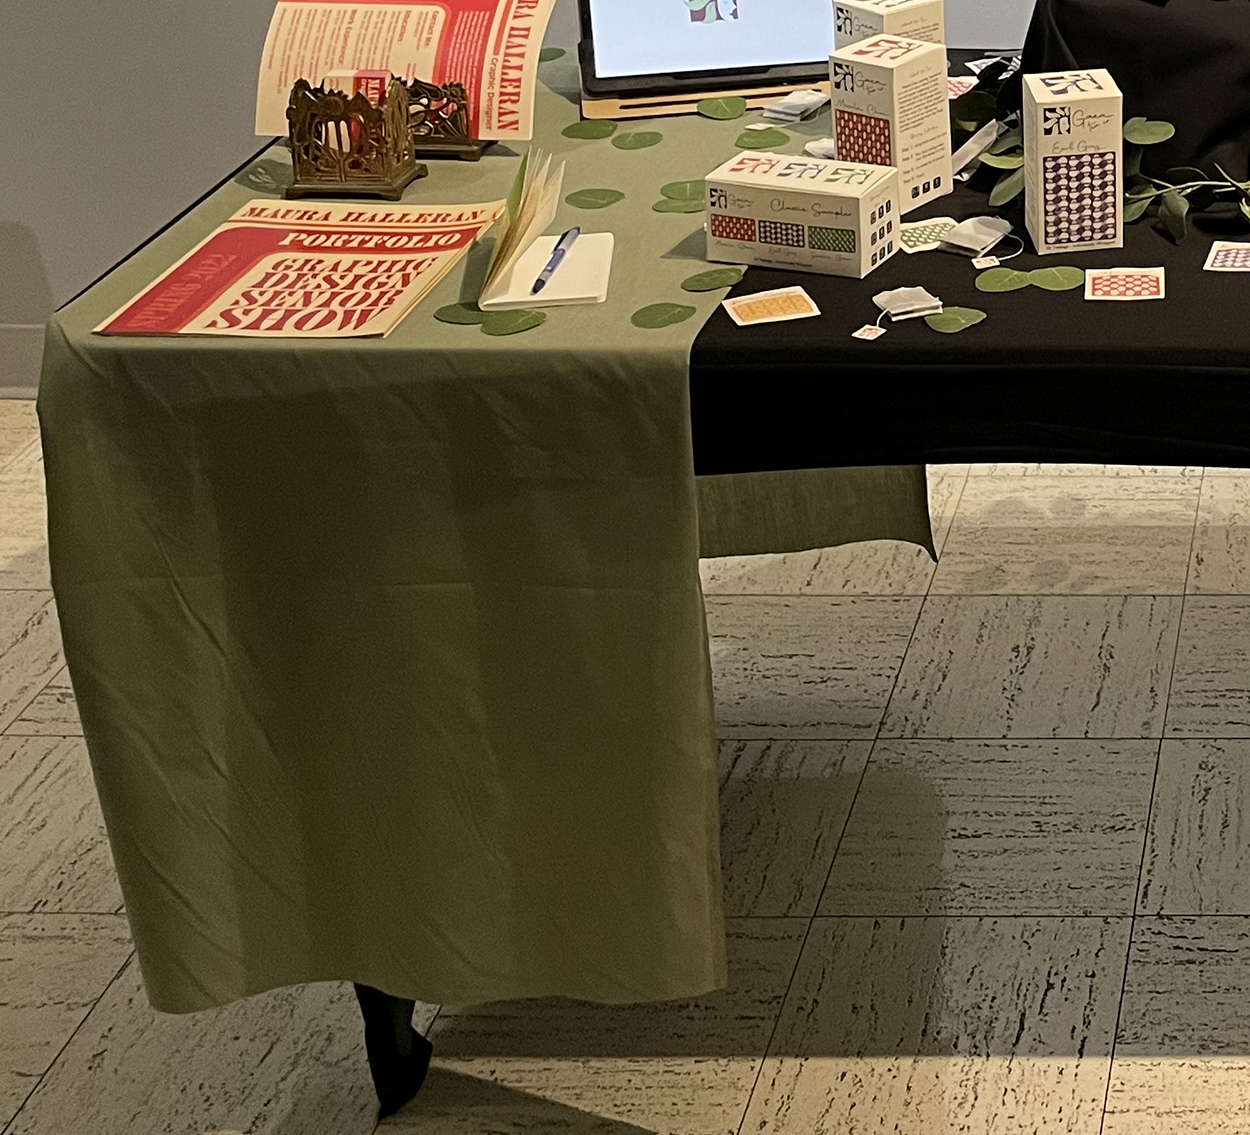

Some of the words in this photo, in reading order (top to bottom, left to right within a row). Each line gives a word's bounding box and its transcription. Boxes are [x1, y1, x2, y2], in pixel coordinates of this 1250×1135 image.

[427, 10, 439, 35] Contact
[487, 57, 499, 92] Graphic
[497, 26, 532, 131] HALLERAN
[485, 93, 495, 130] Designer
[241, 207, 332, 222] MAURA
[340, 210, 485, 223] HALLERAN
[278, 233, 461, 248] PORTFOLIO
[271, 256, 439, 273] GRAPHIC
[250, 271, 426, 290] DESIGN
[229, 289, 404, 308] SENIOR
[204, 307, 394, 331] SHOW
